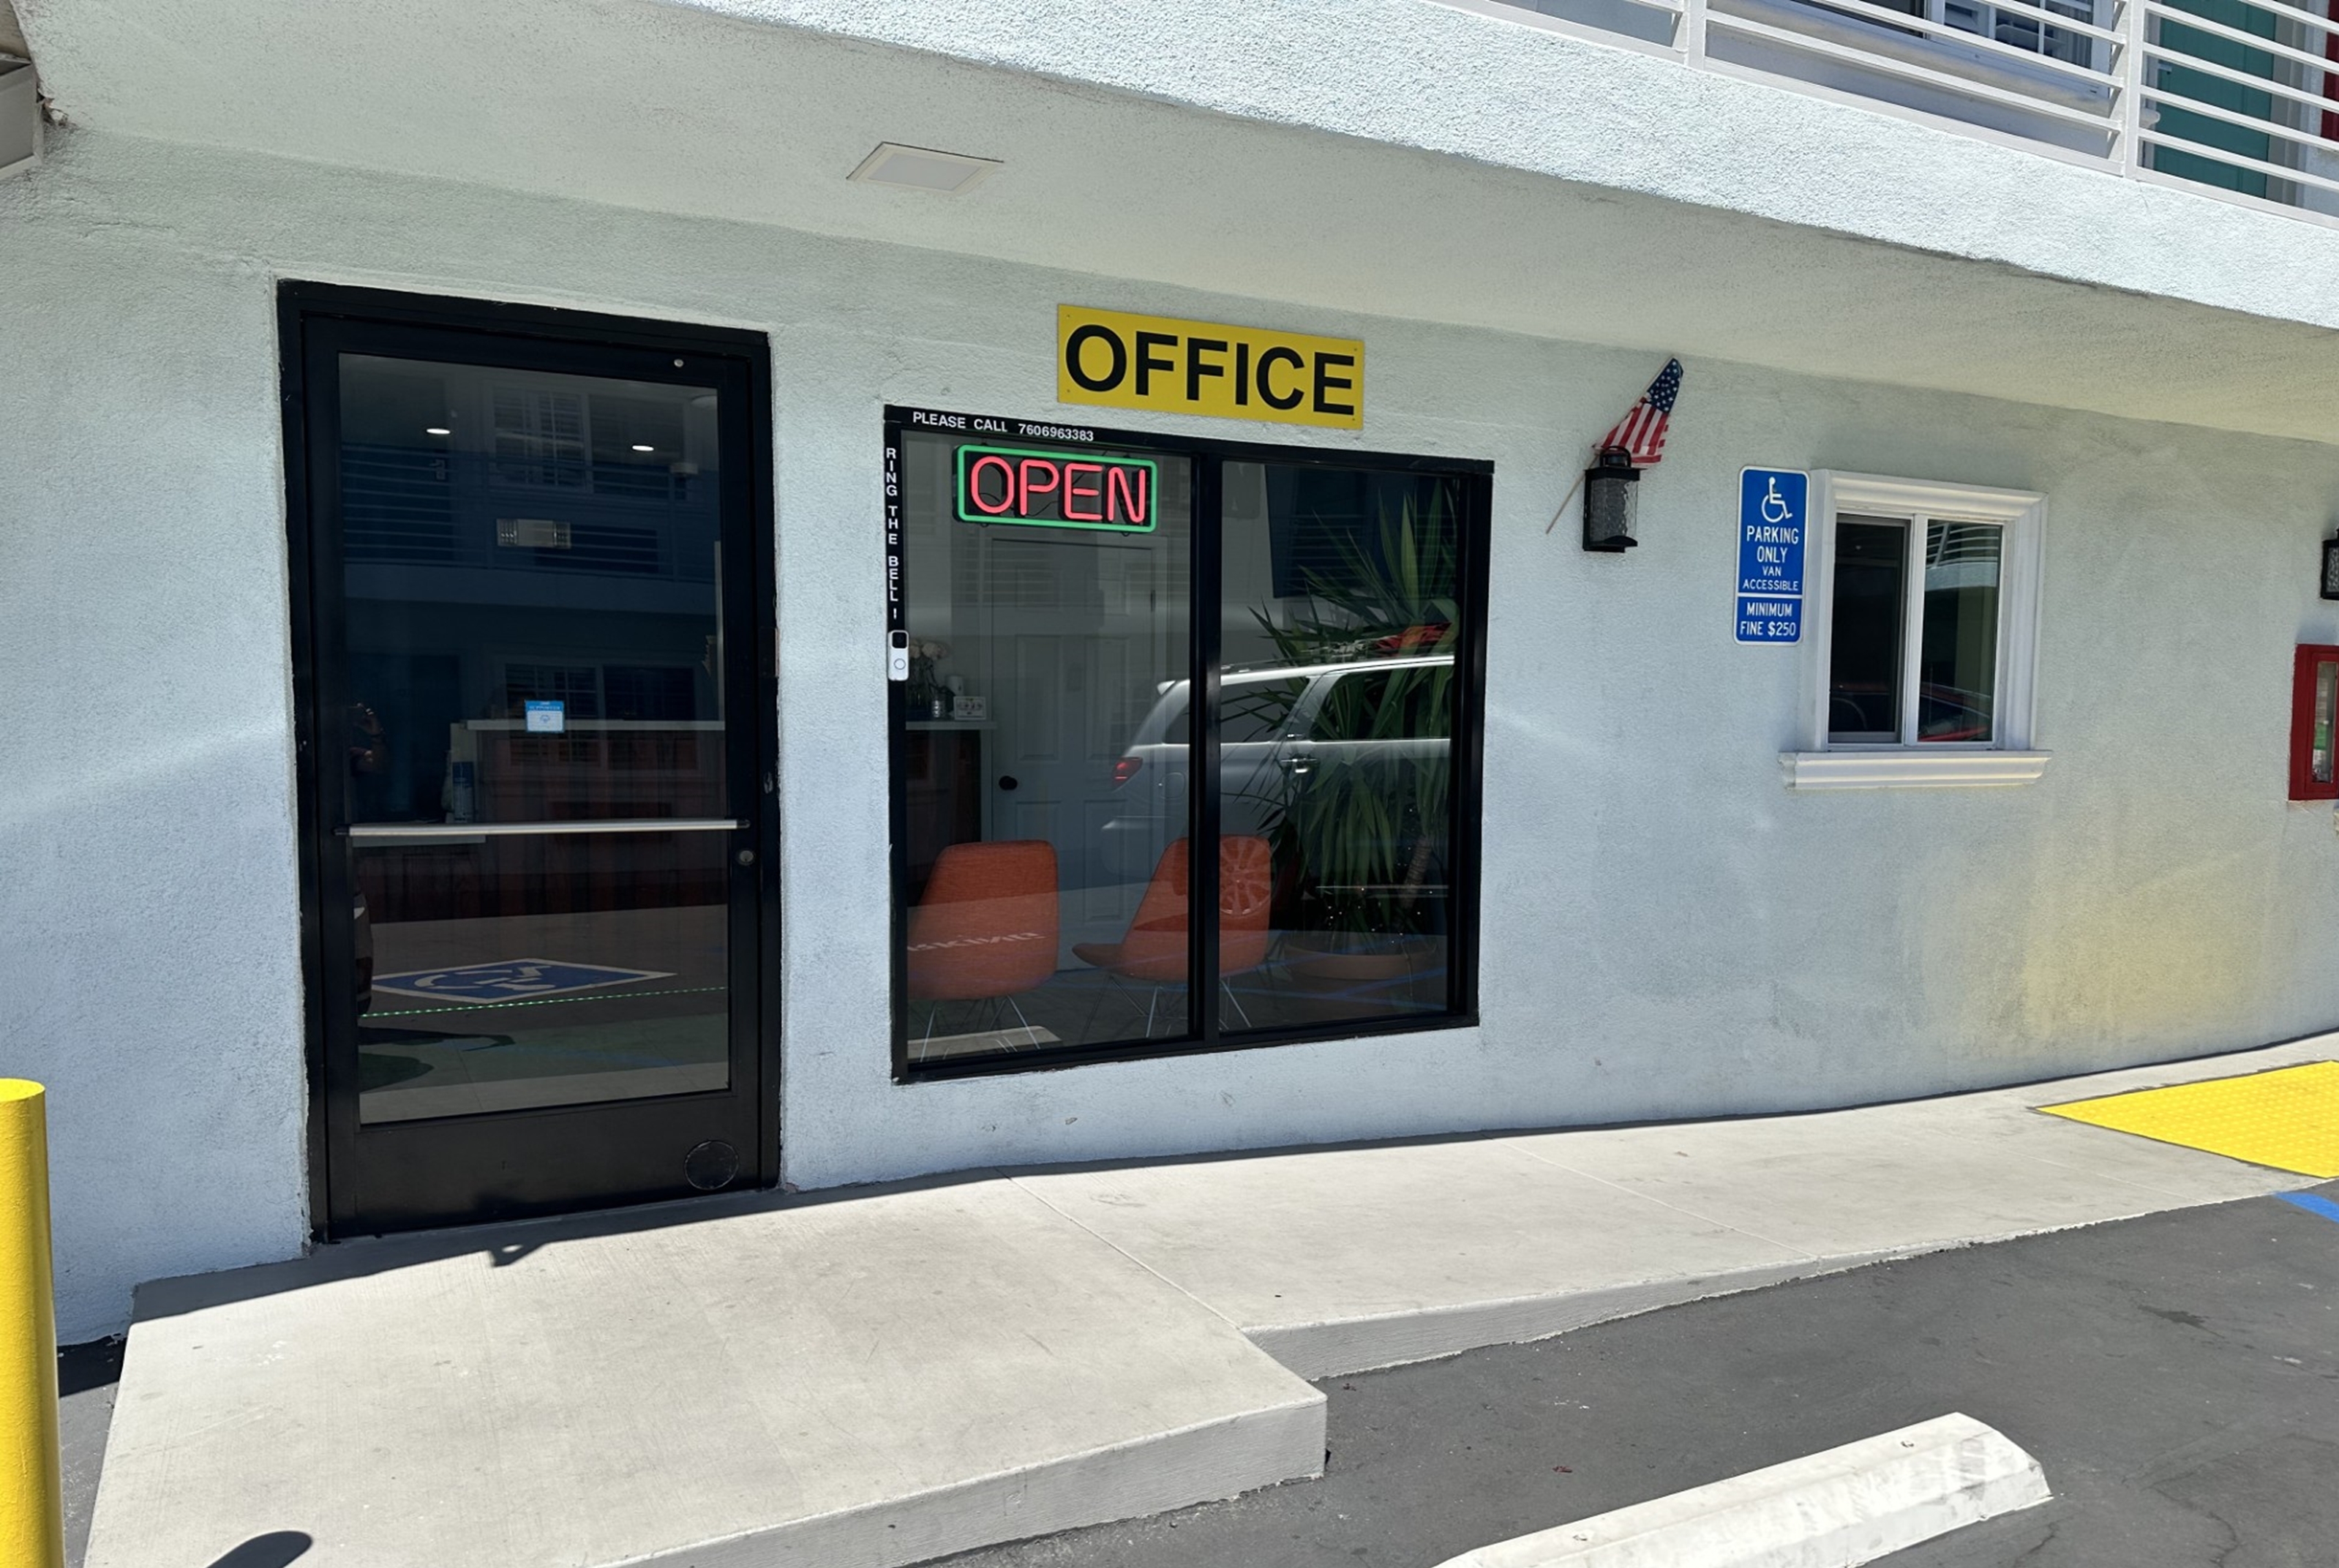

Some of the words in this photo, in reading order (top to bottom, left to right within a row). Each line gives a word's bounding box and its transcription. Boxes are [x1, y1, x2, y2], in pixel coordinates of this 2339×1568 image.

[1065, 324, 1355, 416] OFFICE
[912, 411, 966, 429] PLEASE
[974, 419, 1008, 432] CALL
[1018, 424, 1094, 442] 7606963383
[886, 447, 898, 496] RING
[971, 455, 1146, 523] OPEN
[887, 505, 898, 544] THE
[1746, 525, 1800, 544] PARKING
[1757, 545, 1788, 563] ONLY
[888, 555, 899, 601] BELL
[1762, 566, 1782, 577] VAN
[1742, 578, 1799, 591] ACCESSIBLE
[1746, 601, 1792, 618] MINIMUM
[1740, 620, 1764, 637] FINE
[1768, 621, 1796, 637] $250
